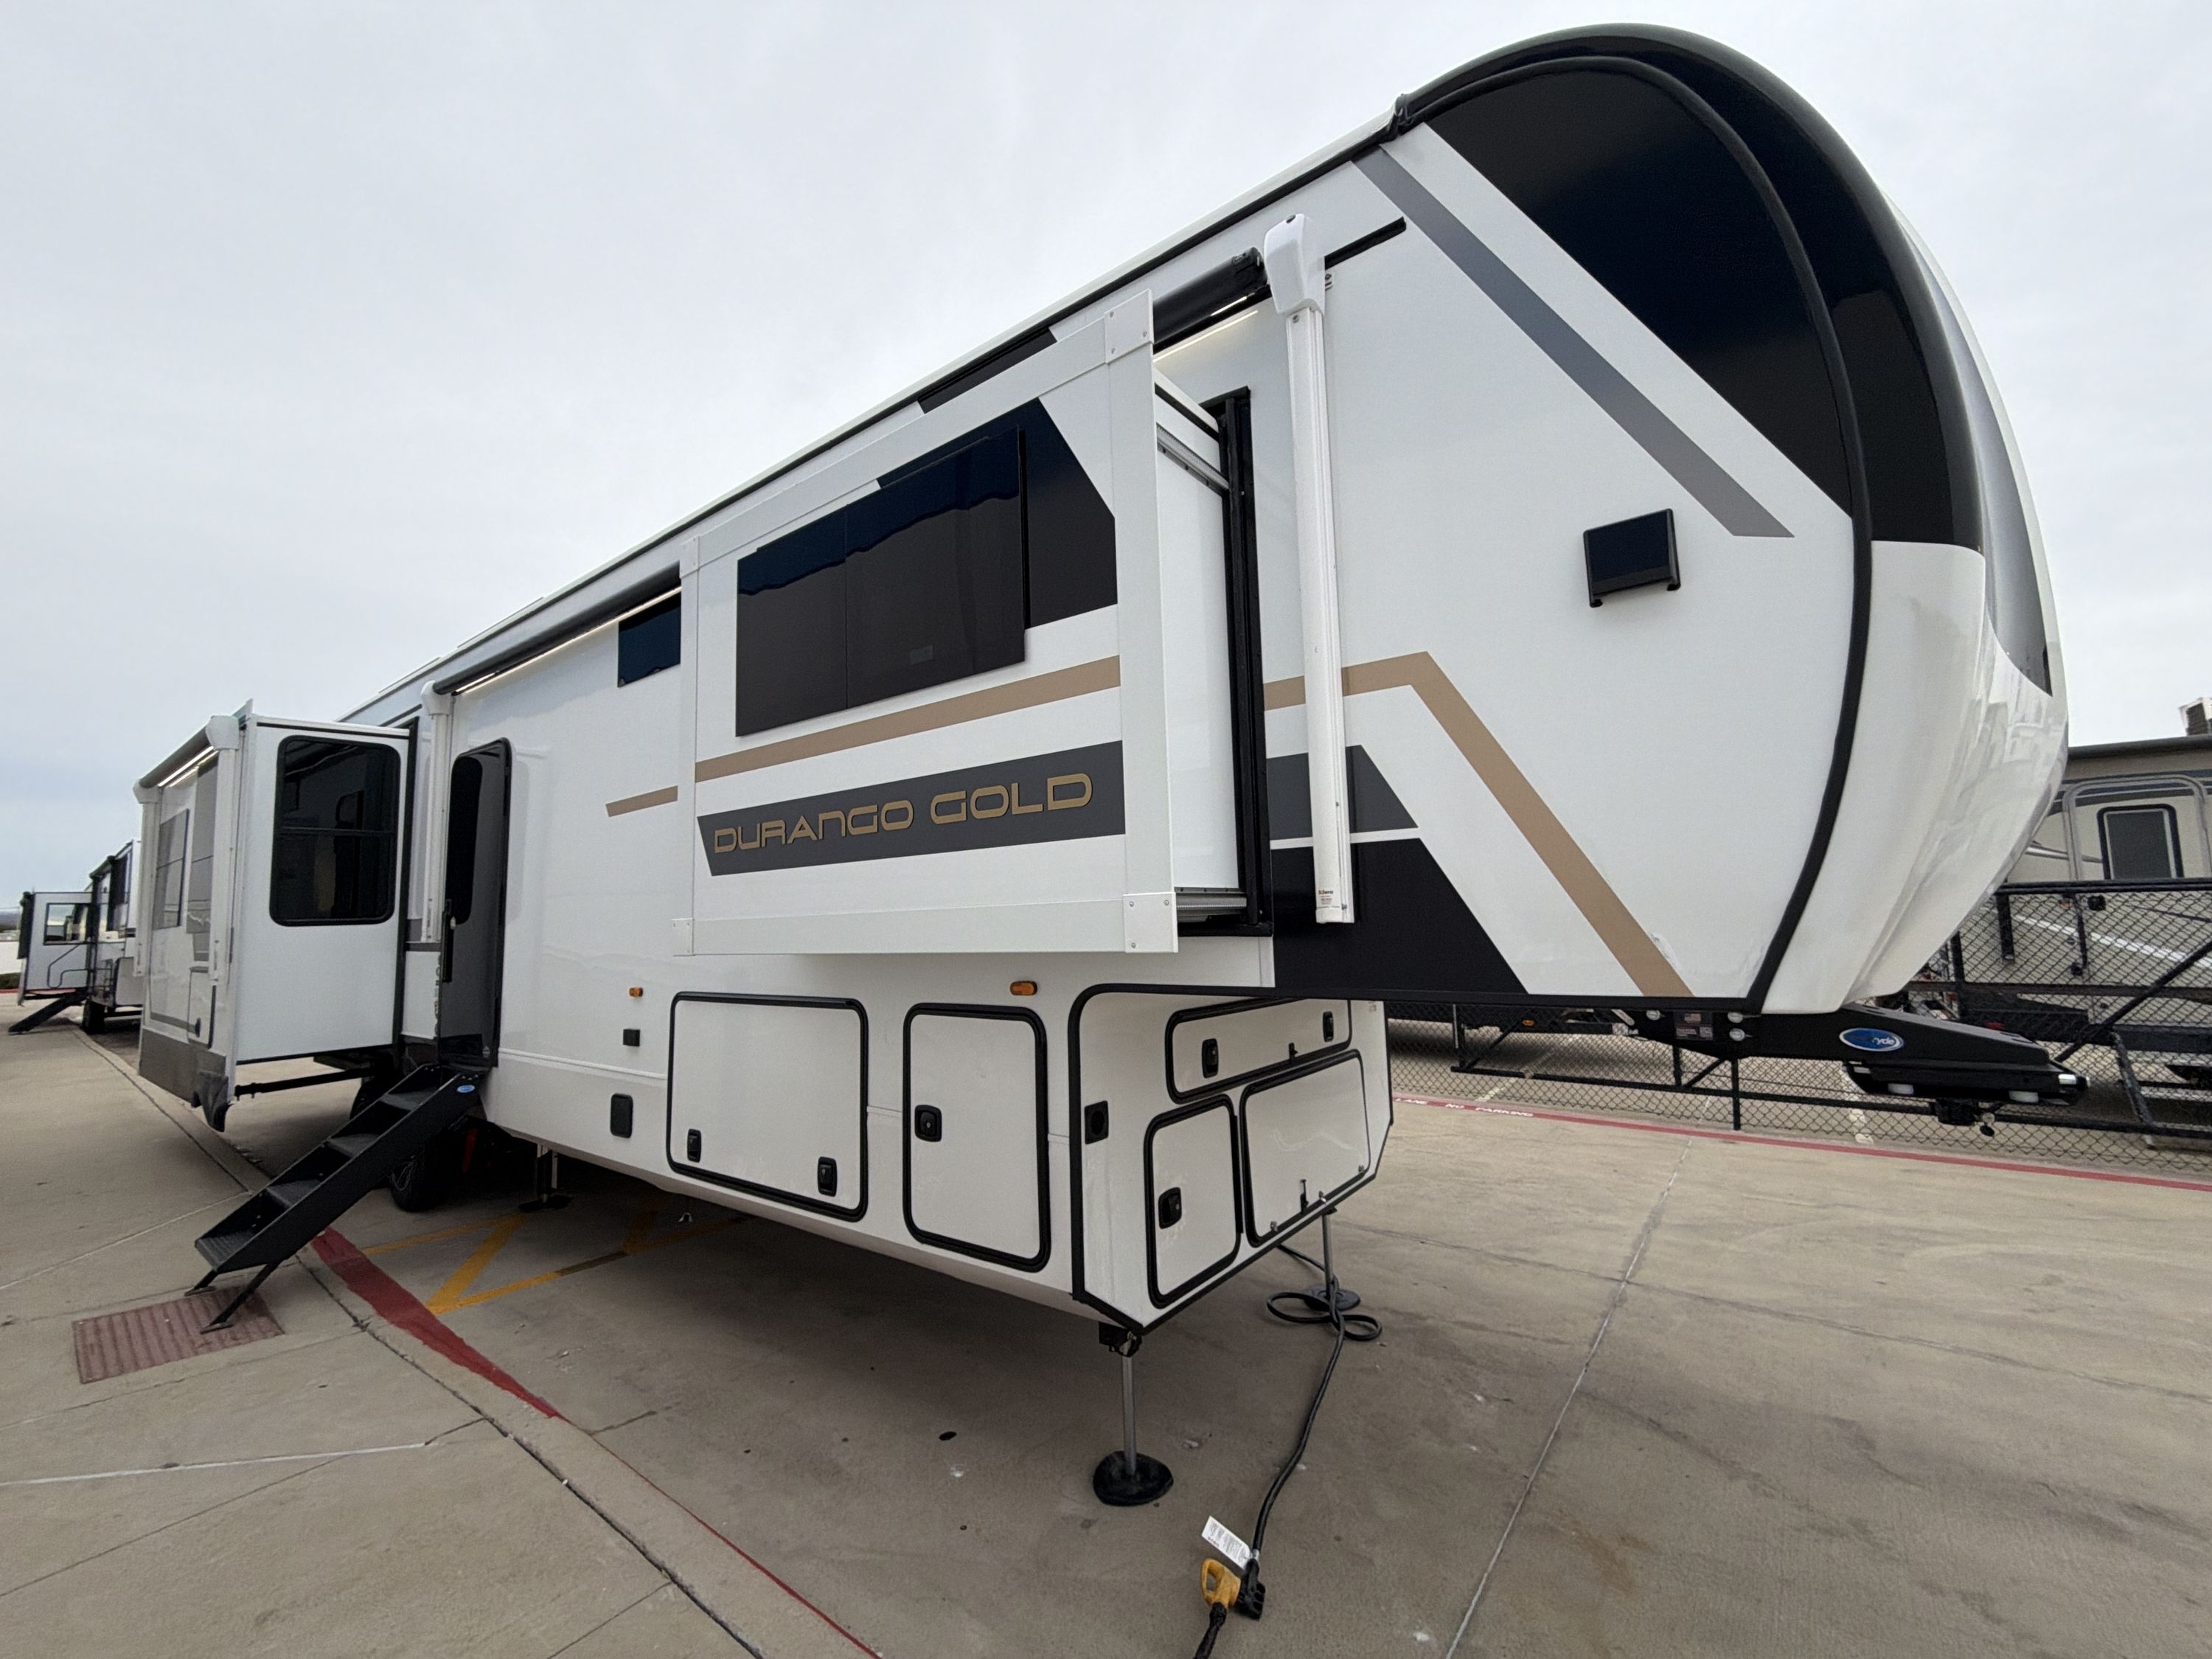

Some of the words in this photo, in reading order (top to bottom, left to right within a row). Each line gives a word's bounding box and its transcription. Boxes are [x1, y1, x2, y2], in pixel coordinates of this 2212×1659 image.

[714, 799, 914, 854] DURANGO
[930, 772, 1093, 825] GOLD
[1475, 1107, 1534, 1117] PARKING
